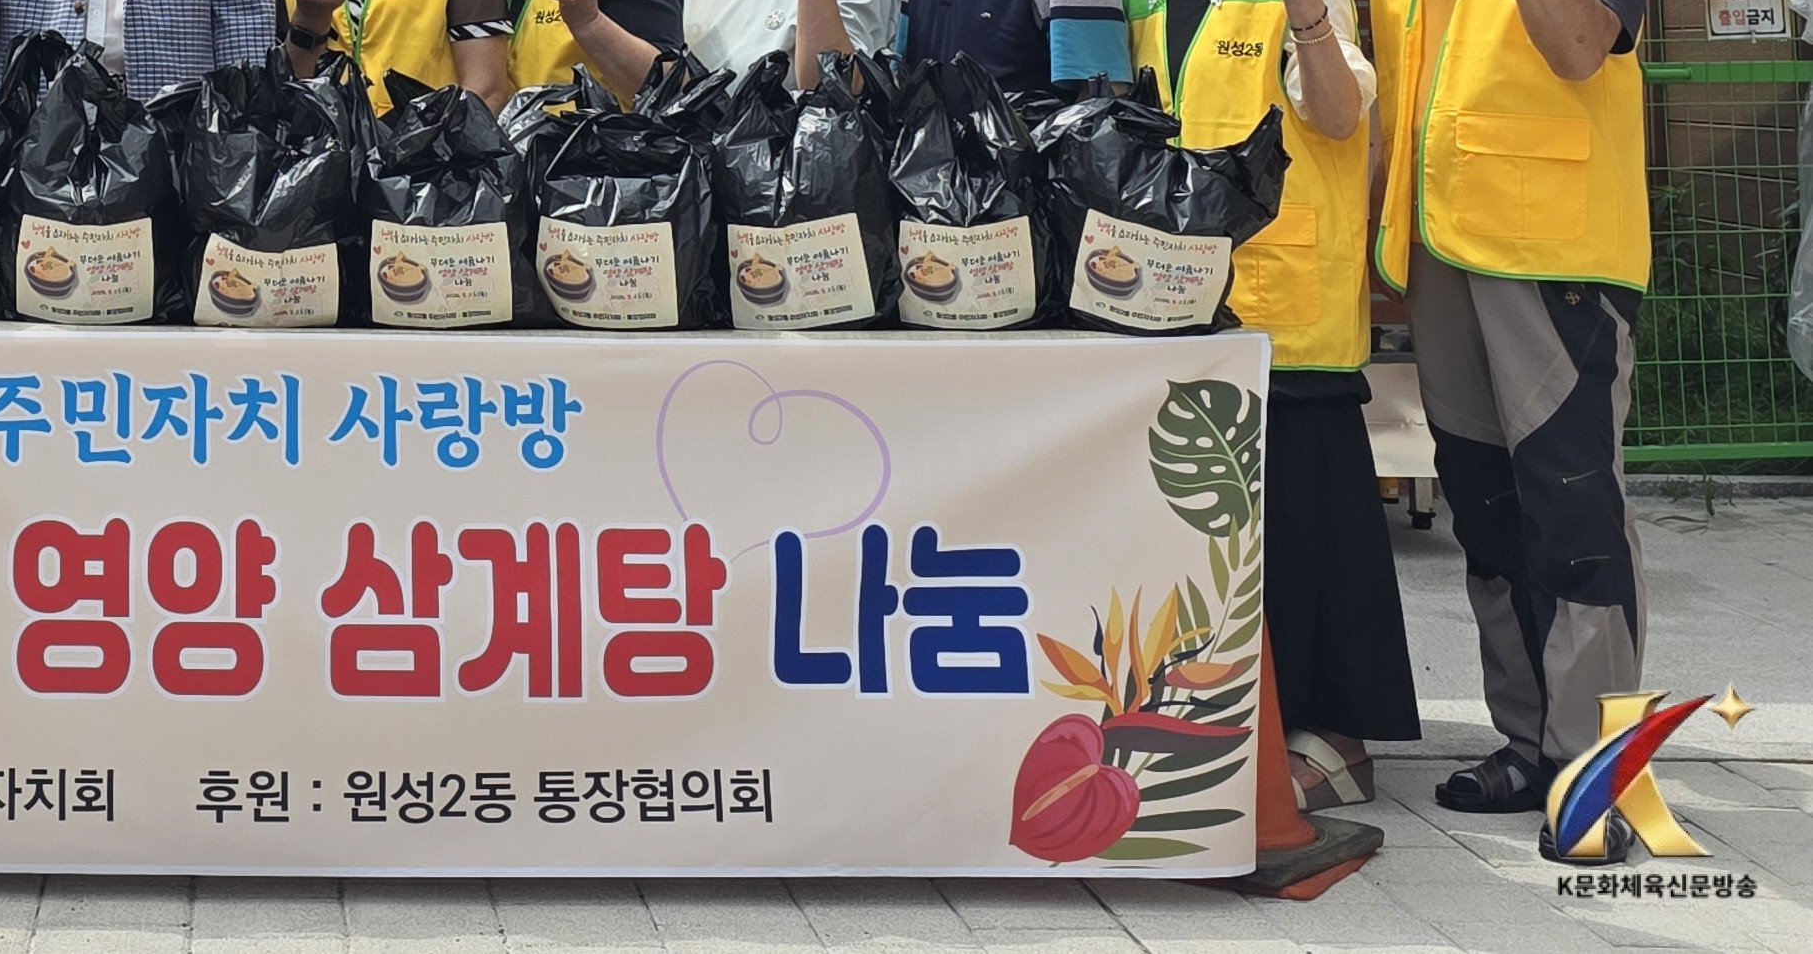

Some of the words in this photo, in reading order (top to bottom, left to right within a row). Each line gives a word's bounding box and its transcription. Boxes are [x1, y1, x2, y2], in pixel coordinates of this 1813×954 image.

[1718, 8, 1775, 27] 출입금지
[1217, 39, 1264, 58] 원성2동
[107, 250, 140, 262] 여름나기
[813, 246, 849, 259] 여름나기
[987, 249, 1020, 262] 여름나기
[622, 255, 659, 266] 여름나기
[1175, 265, 1213, 275] 여름나기
[289, 276, 325, 285] 여름나기
[328, 375, 583, 470] 사랑방
[13, 518, 277, 697] 영양
[321, 520, 728, 699] 삼계탕
[772, 524, 1030, 694] 나눔
[195, 769, 291, 823] 후원
[312, 779, 323, 813] :
[342, 768, 517, 824] 원성2동
[533, 767, 774, 824] 통장협의회
